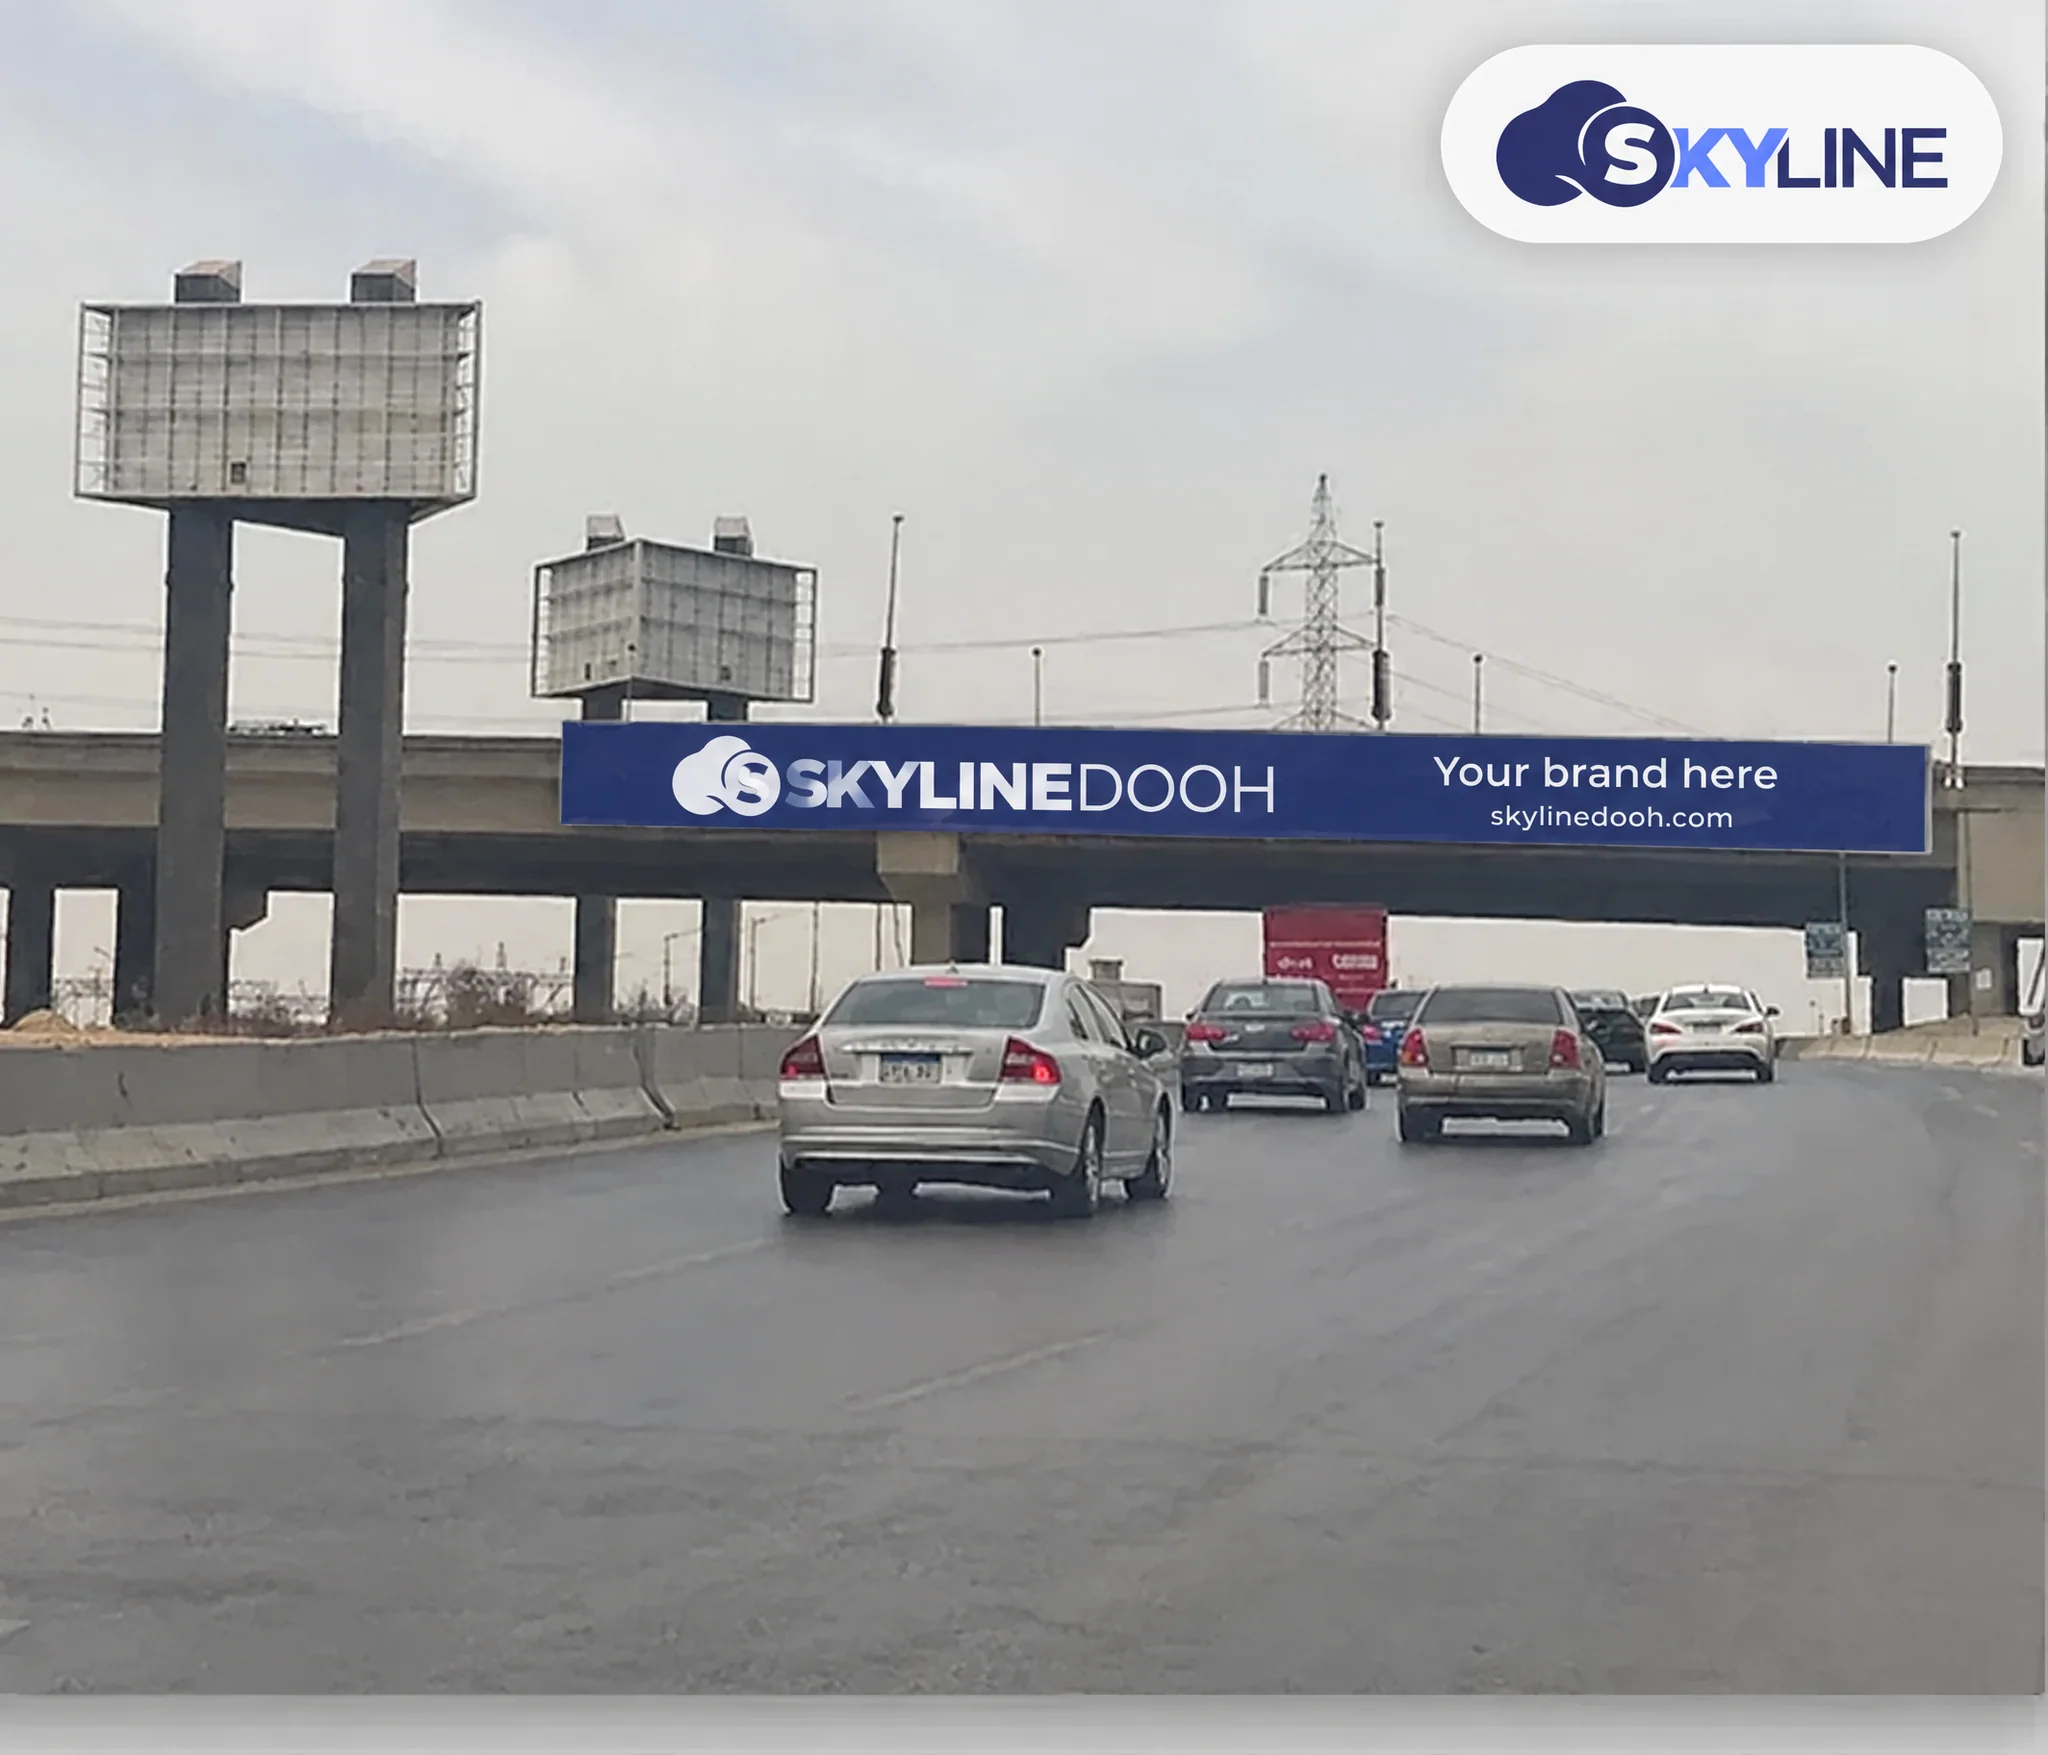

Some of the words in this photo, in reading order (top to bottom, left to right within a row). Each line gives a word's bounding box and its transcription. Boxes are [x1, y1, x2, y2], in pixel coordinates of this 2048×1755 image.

[785, 758, 1274, 813] SKYLINEDOOH
[1433, 756, 1530, 787] Your
[1544, 756, 1667, 789] brand
[1683, 757, 1778, 790] here
[1490, 804, 1733, 831] skylinedooh.com
